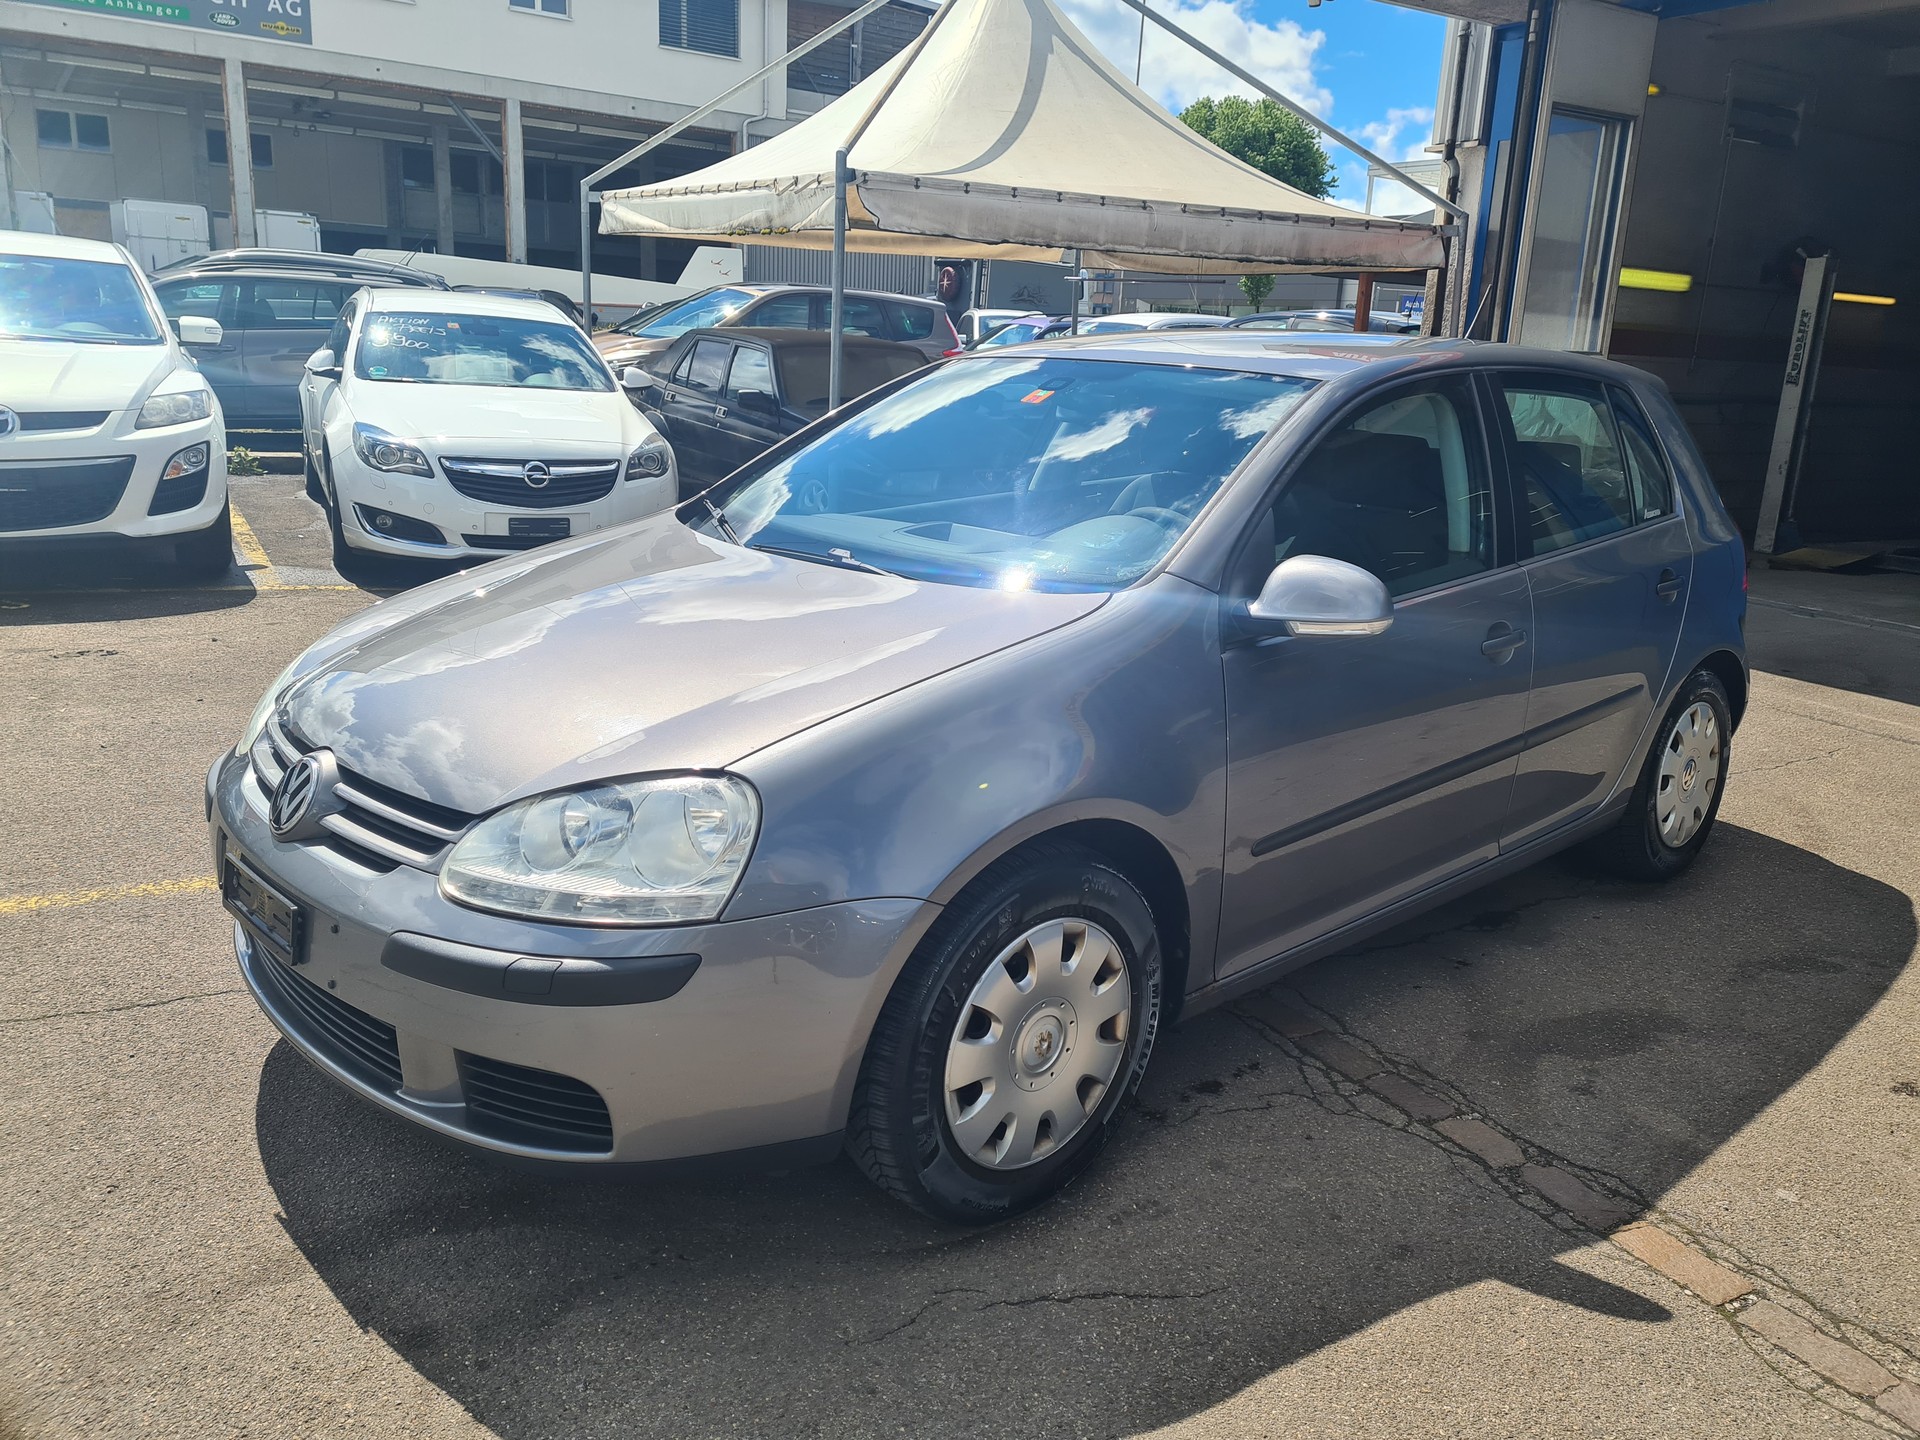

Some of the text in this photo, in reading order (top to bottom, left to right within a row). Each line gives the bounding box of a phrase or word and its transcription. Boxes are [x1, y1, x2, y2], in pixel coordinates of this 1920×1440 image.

[105, 0, 180, 16] Anhänger
[267, 0, 302, 16] AG
[1131, 983, 1160, 1089] MICHELIN
